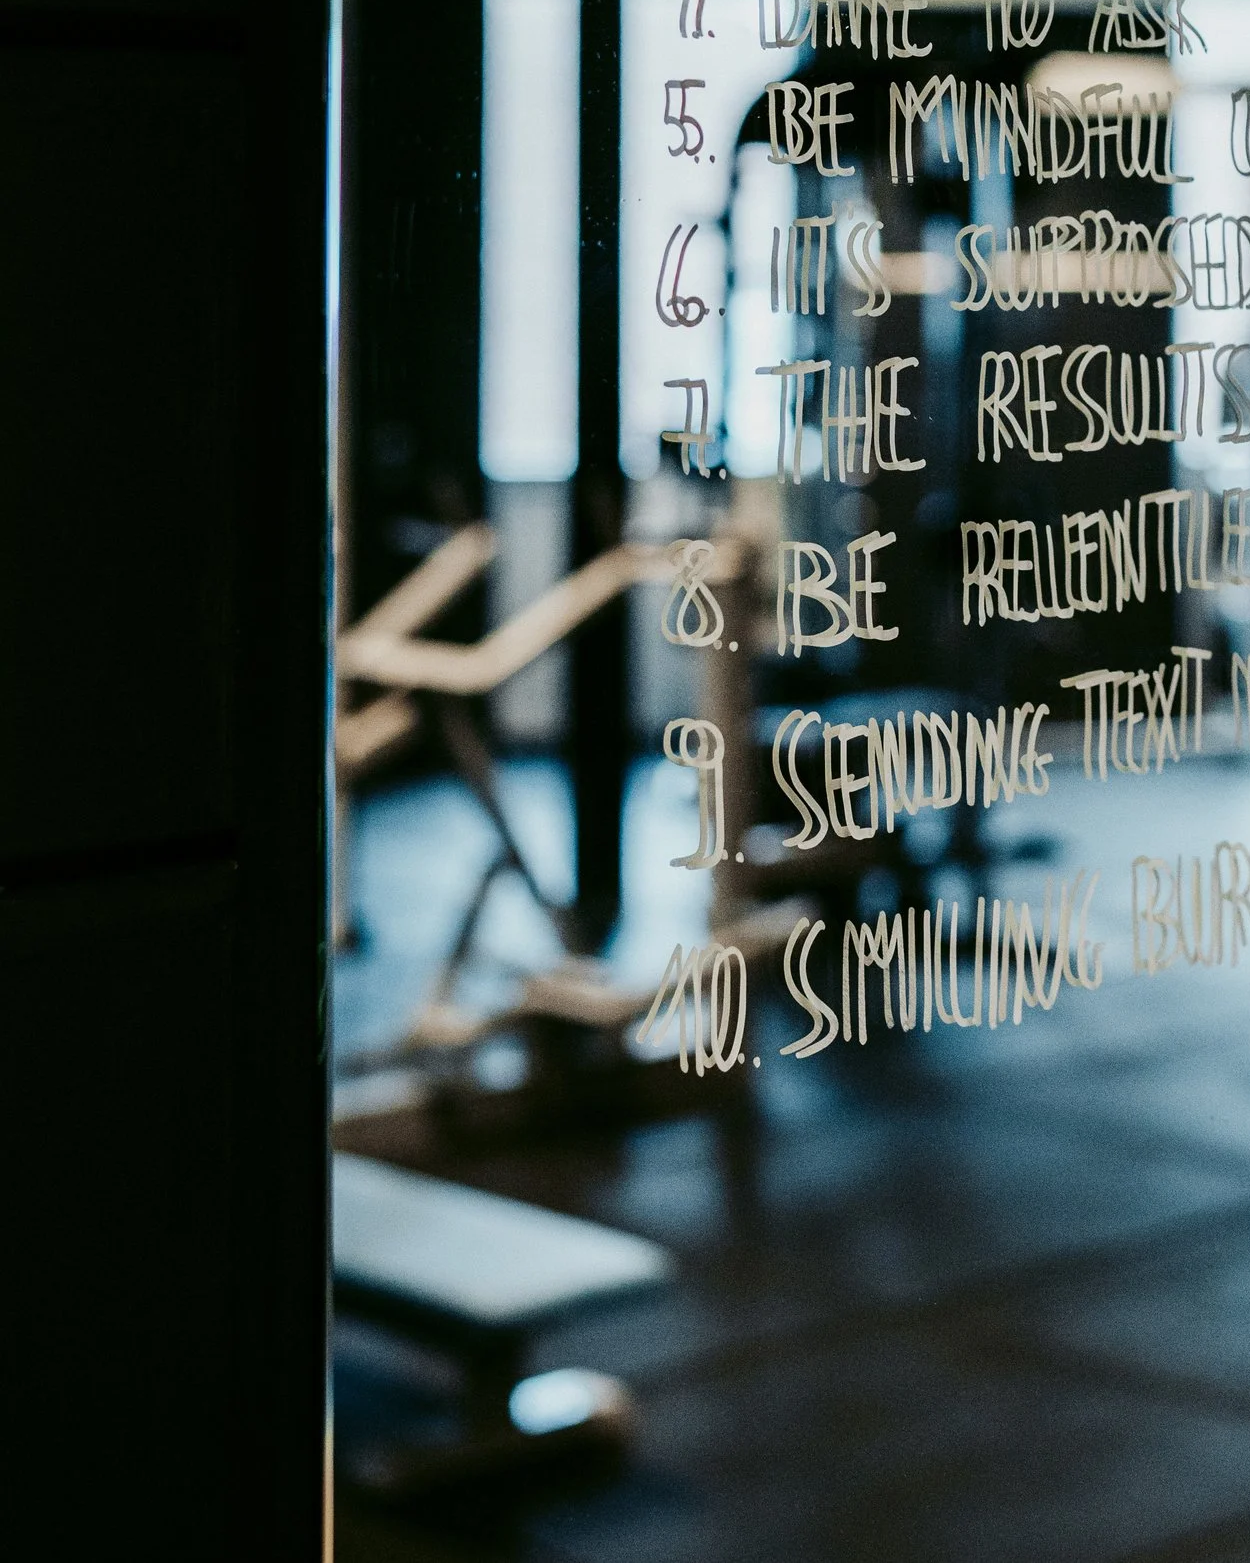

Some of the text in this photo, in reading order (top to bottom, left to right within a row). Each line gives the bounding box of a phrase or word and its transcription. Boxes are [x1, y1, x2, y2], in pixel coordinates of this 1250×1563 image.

[663, 79, 716, 165] 5.
[764, 80, 855, 177] BE
[888, 73, 1194, 185] MINDFUL
[656, 223, 726, 328] 6.
[661, 378, 727, 480] 7.
[755, 356, 926, 485] THE
[661, 538, 739, 652] 8.
[776, 530, 899, 658] BE
[663, 717, 745, 870] 9.
[772, 701, 1054, 850] SENDING
[1060, 645, 1213, 781] TEXT
[635, 942, 761, 1077] 10.
[780, 869, 1103, 1059] SMILING
